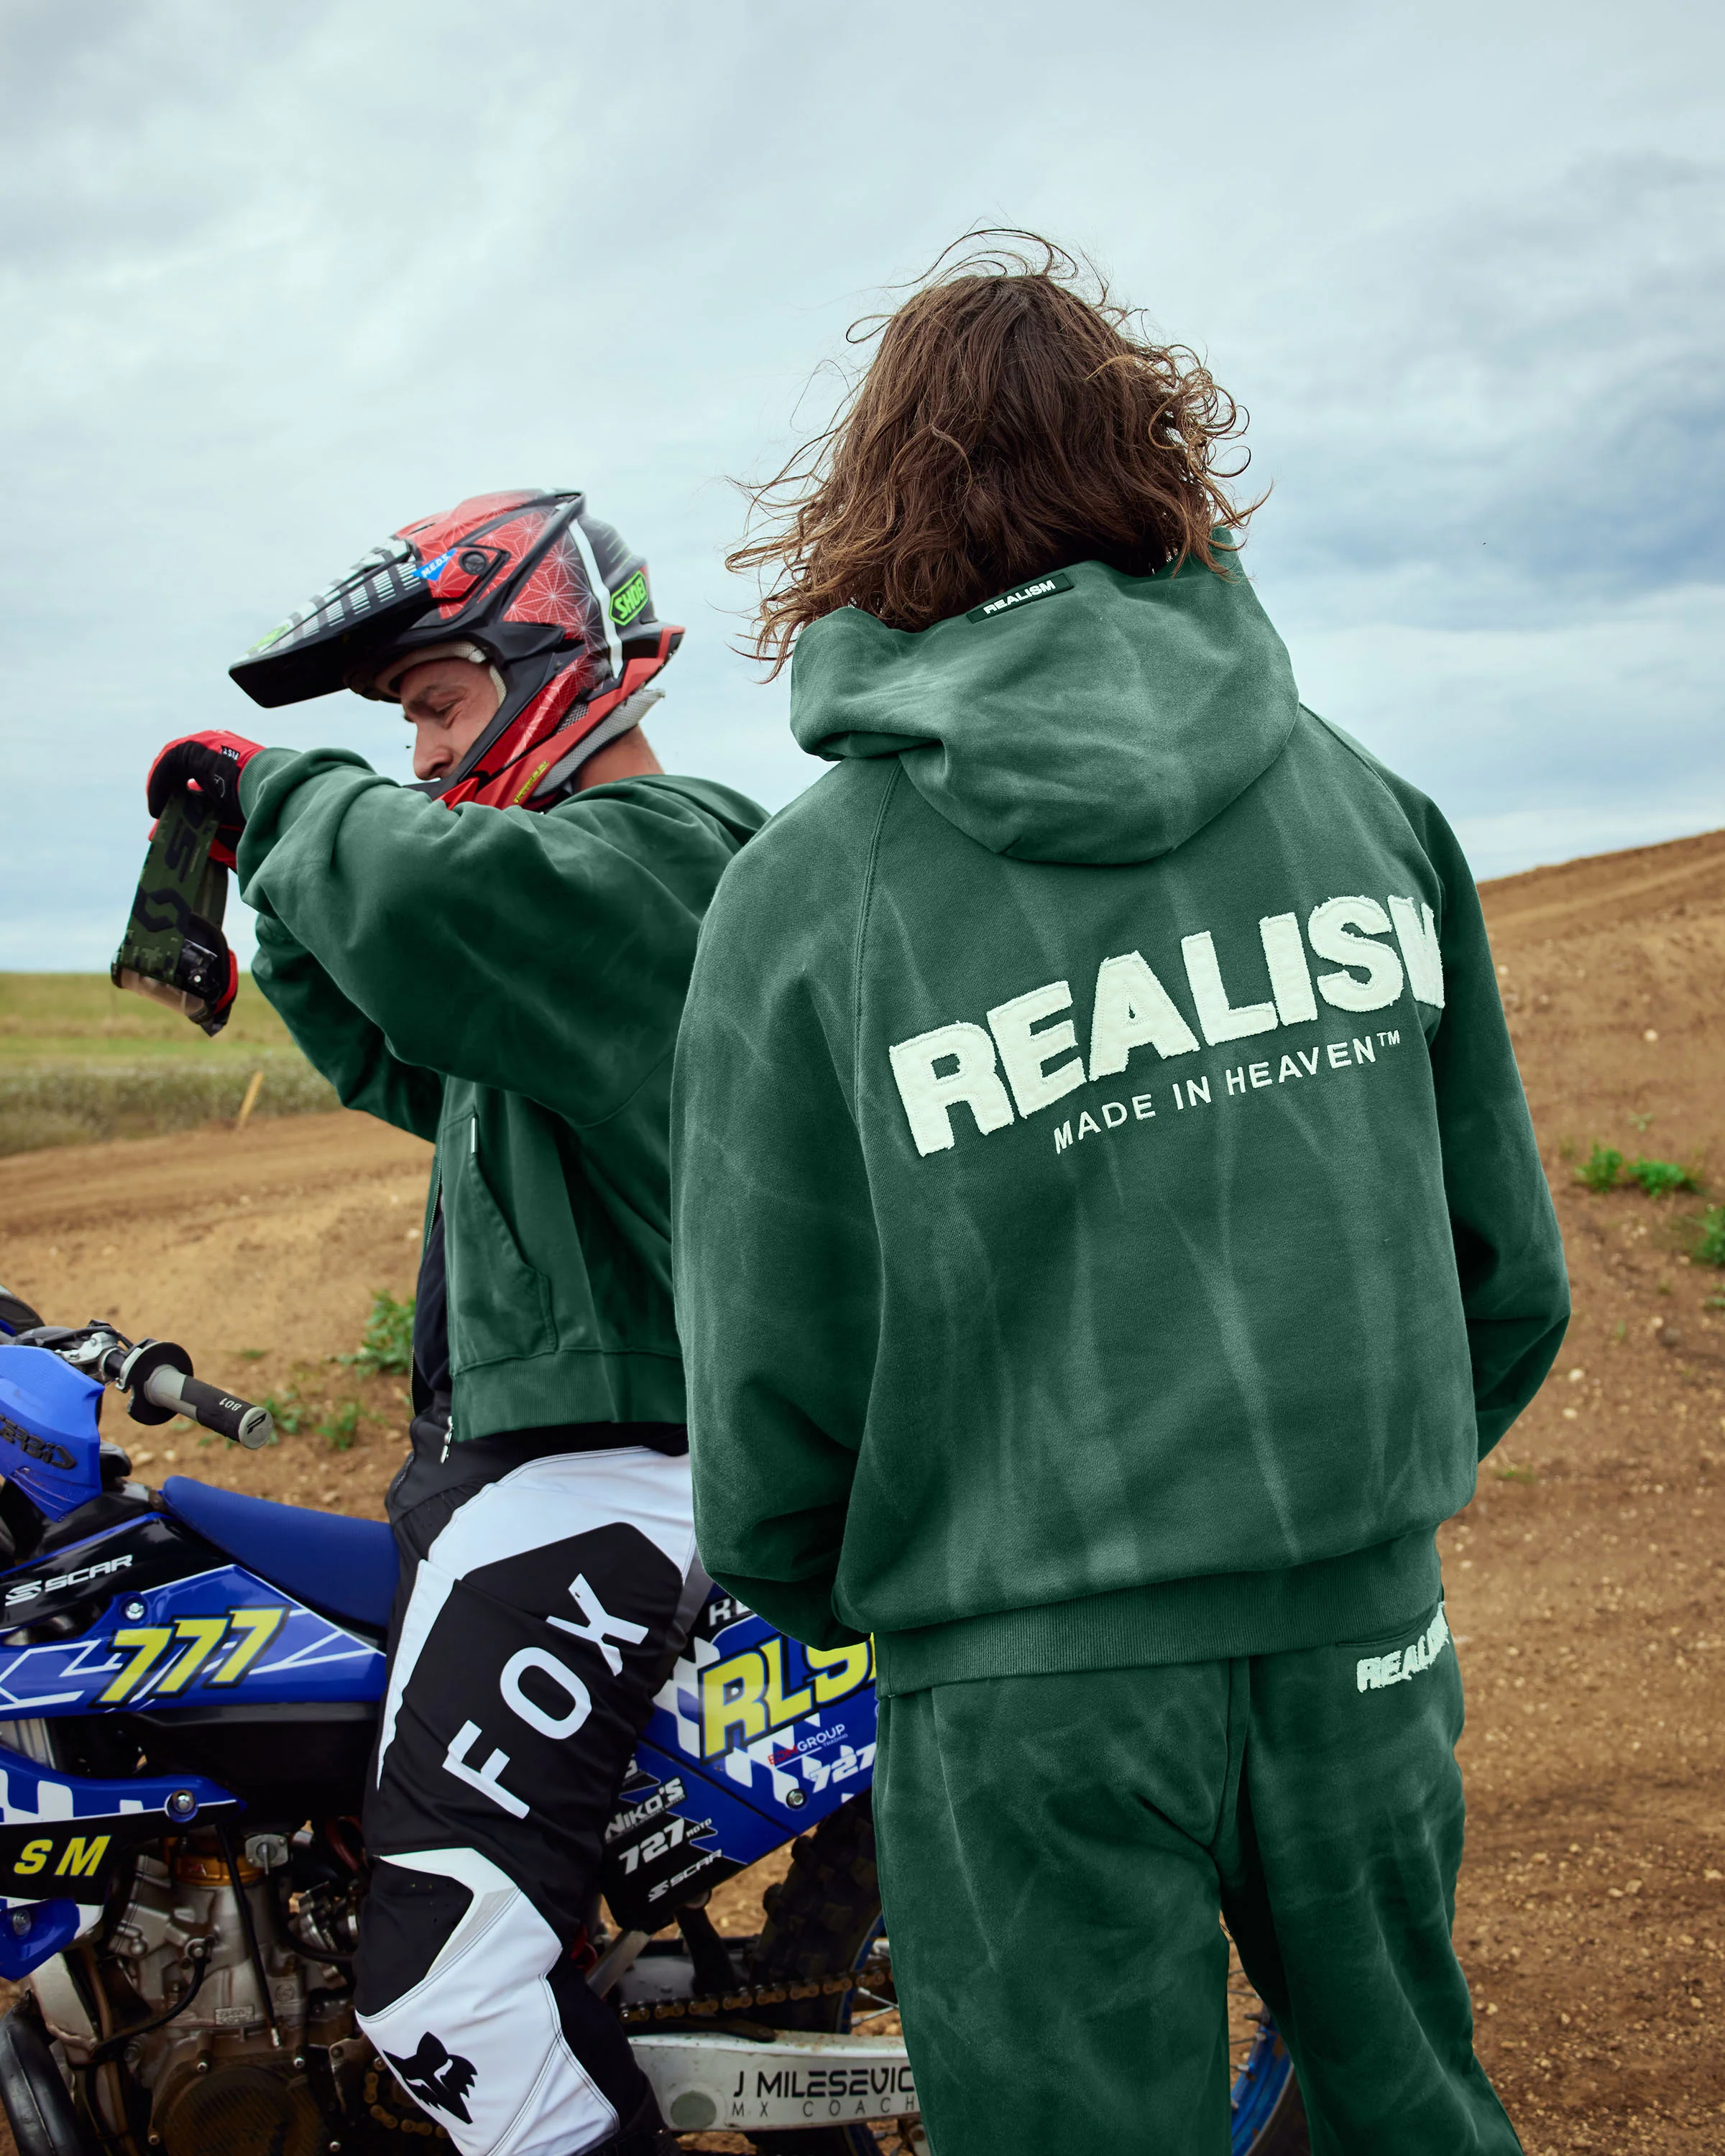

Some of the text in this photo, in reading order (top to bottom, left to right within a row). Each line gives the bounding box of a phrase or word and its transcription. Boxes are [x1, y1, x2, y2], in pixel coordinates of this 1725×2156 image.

[983, 579, 1056, 614] REALISM
[1053, 1093, 1156, 1155] MADE
[1171, 1075, 1213, 1110] IN
[218, 1397, 242, 1411] 801
[45, 1554, 134, 1593] SCAR
[99, 1607, 286, 1703] 777
[442, 1573, 649, 1819] FOX
[703, 1631, 877, 1759] RLS
[604, 1777, 685, 1843] NIKO'S
[619, 1817, 685, 1875] 727
[686, 1818, 713, 1838] MOTO
[670, 1848, 723, 1887] SCAR
[732, 2095, 915, 2117] MX COACH
[733, 2070, 745, 2097] J
